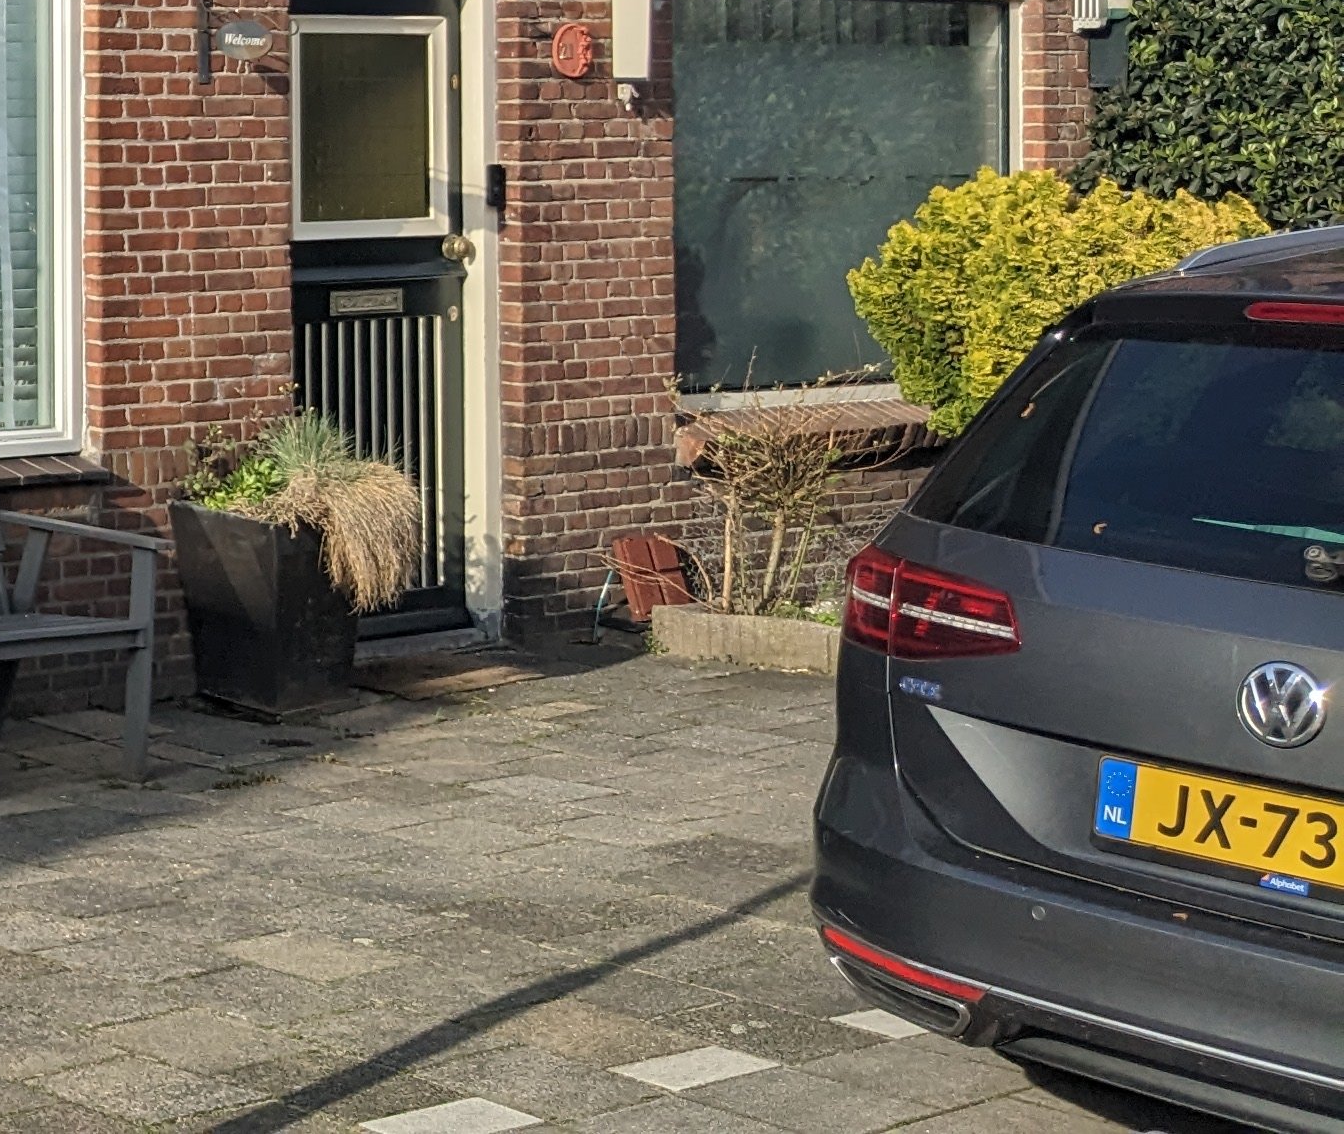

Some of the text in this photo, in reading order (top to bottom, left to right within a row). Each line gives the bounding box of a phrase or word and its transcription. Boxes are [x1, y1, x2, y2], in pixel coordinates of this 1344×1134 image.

[224, 32, 266, 47] Welcome
[1103, 804, 1127, 825] NL
[1269, 877, 1305, 893] Alphabet
